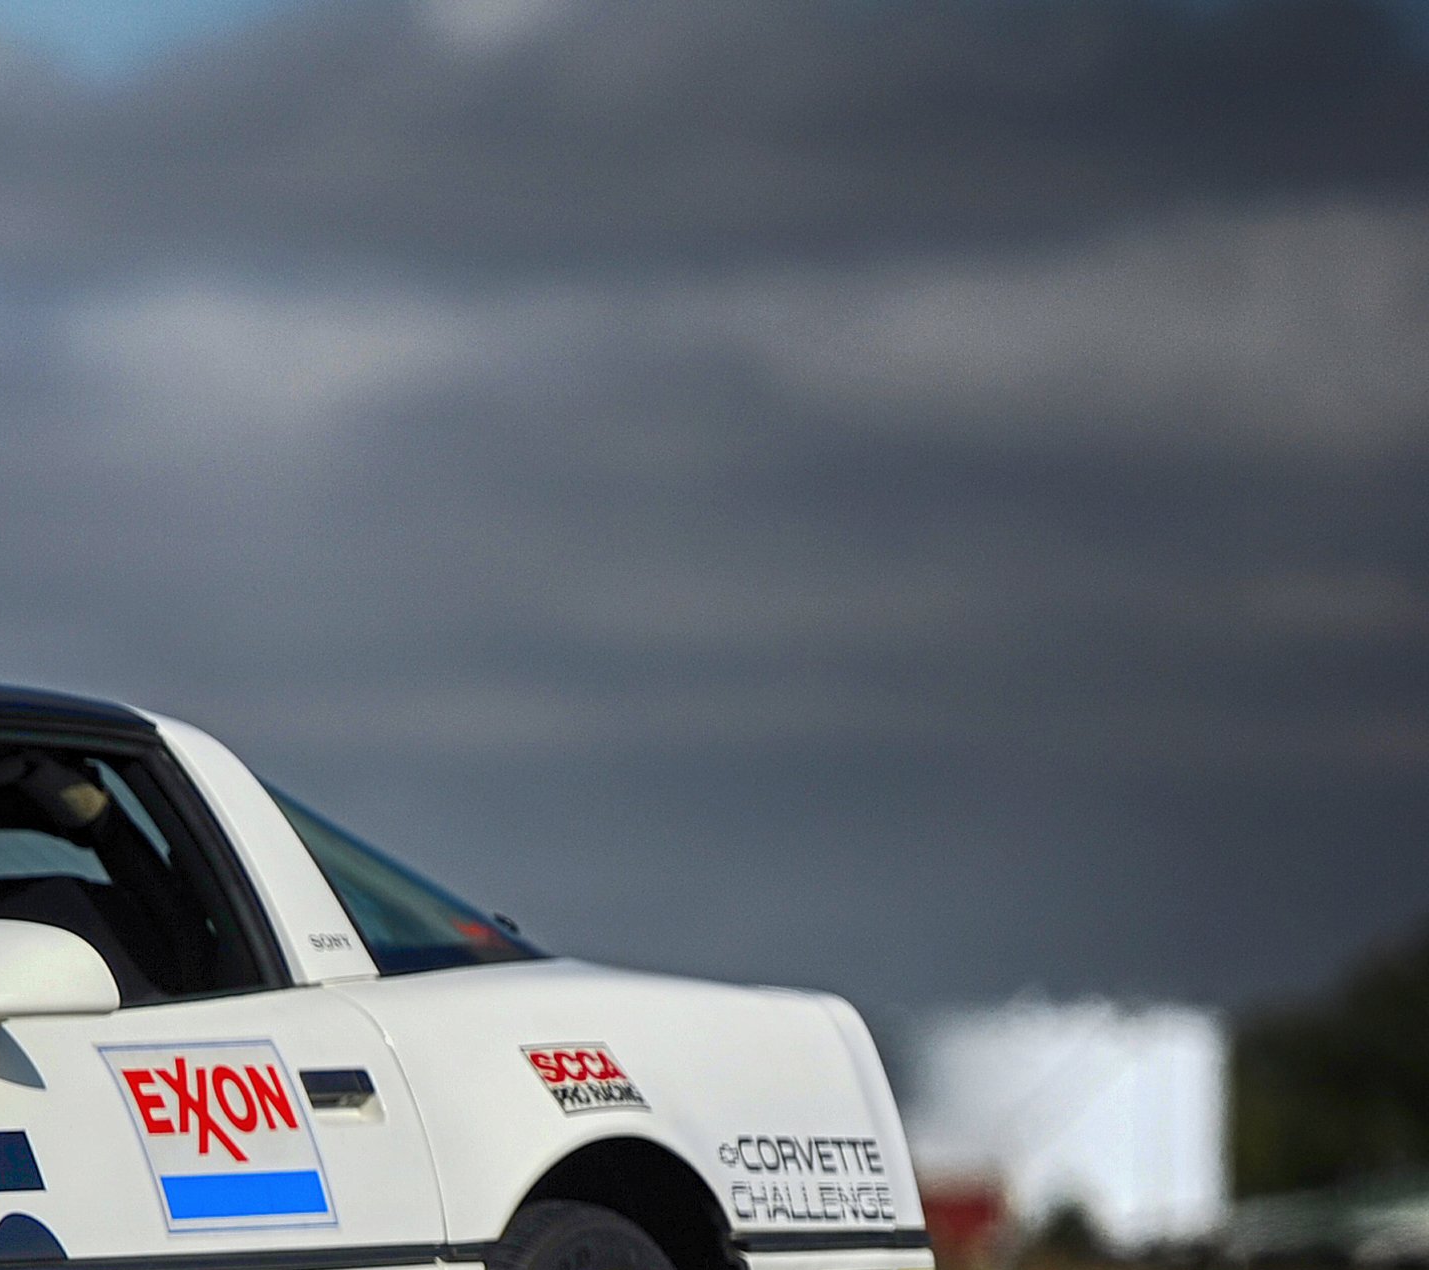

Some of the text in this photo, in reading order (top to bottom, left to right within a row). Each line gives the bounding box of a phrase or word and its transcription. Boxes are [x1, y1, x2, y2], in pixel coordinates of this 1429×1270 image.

[530, 1050, 627, 1082] SCCA
[122, 1057, 299, 1162] EXXON
[737, 1136, 884, 1172] CORVETTE
[732, 1182, 896, 1219] CHALLENGE
